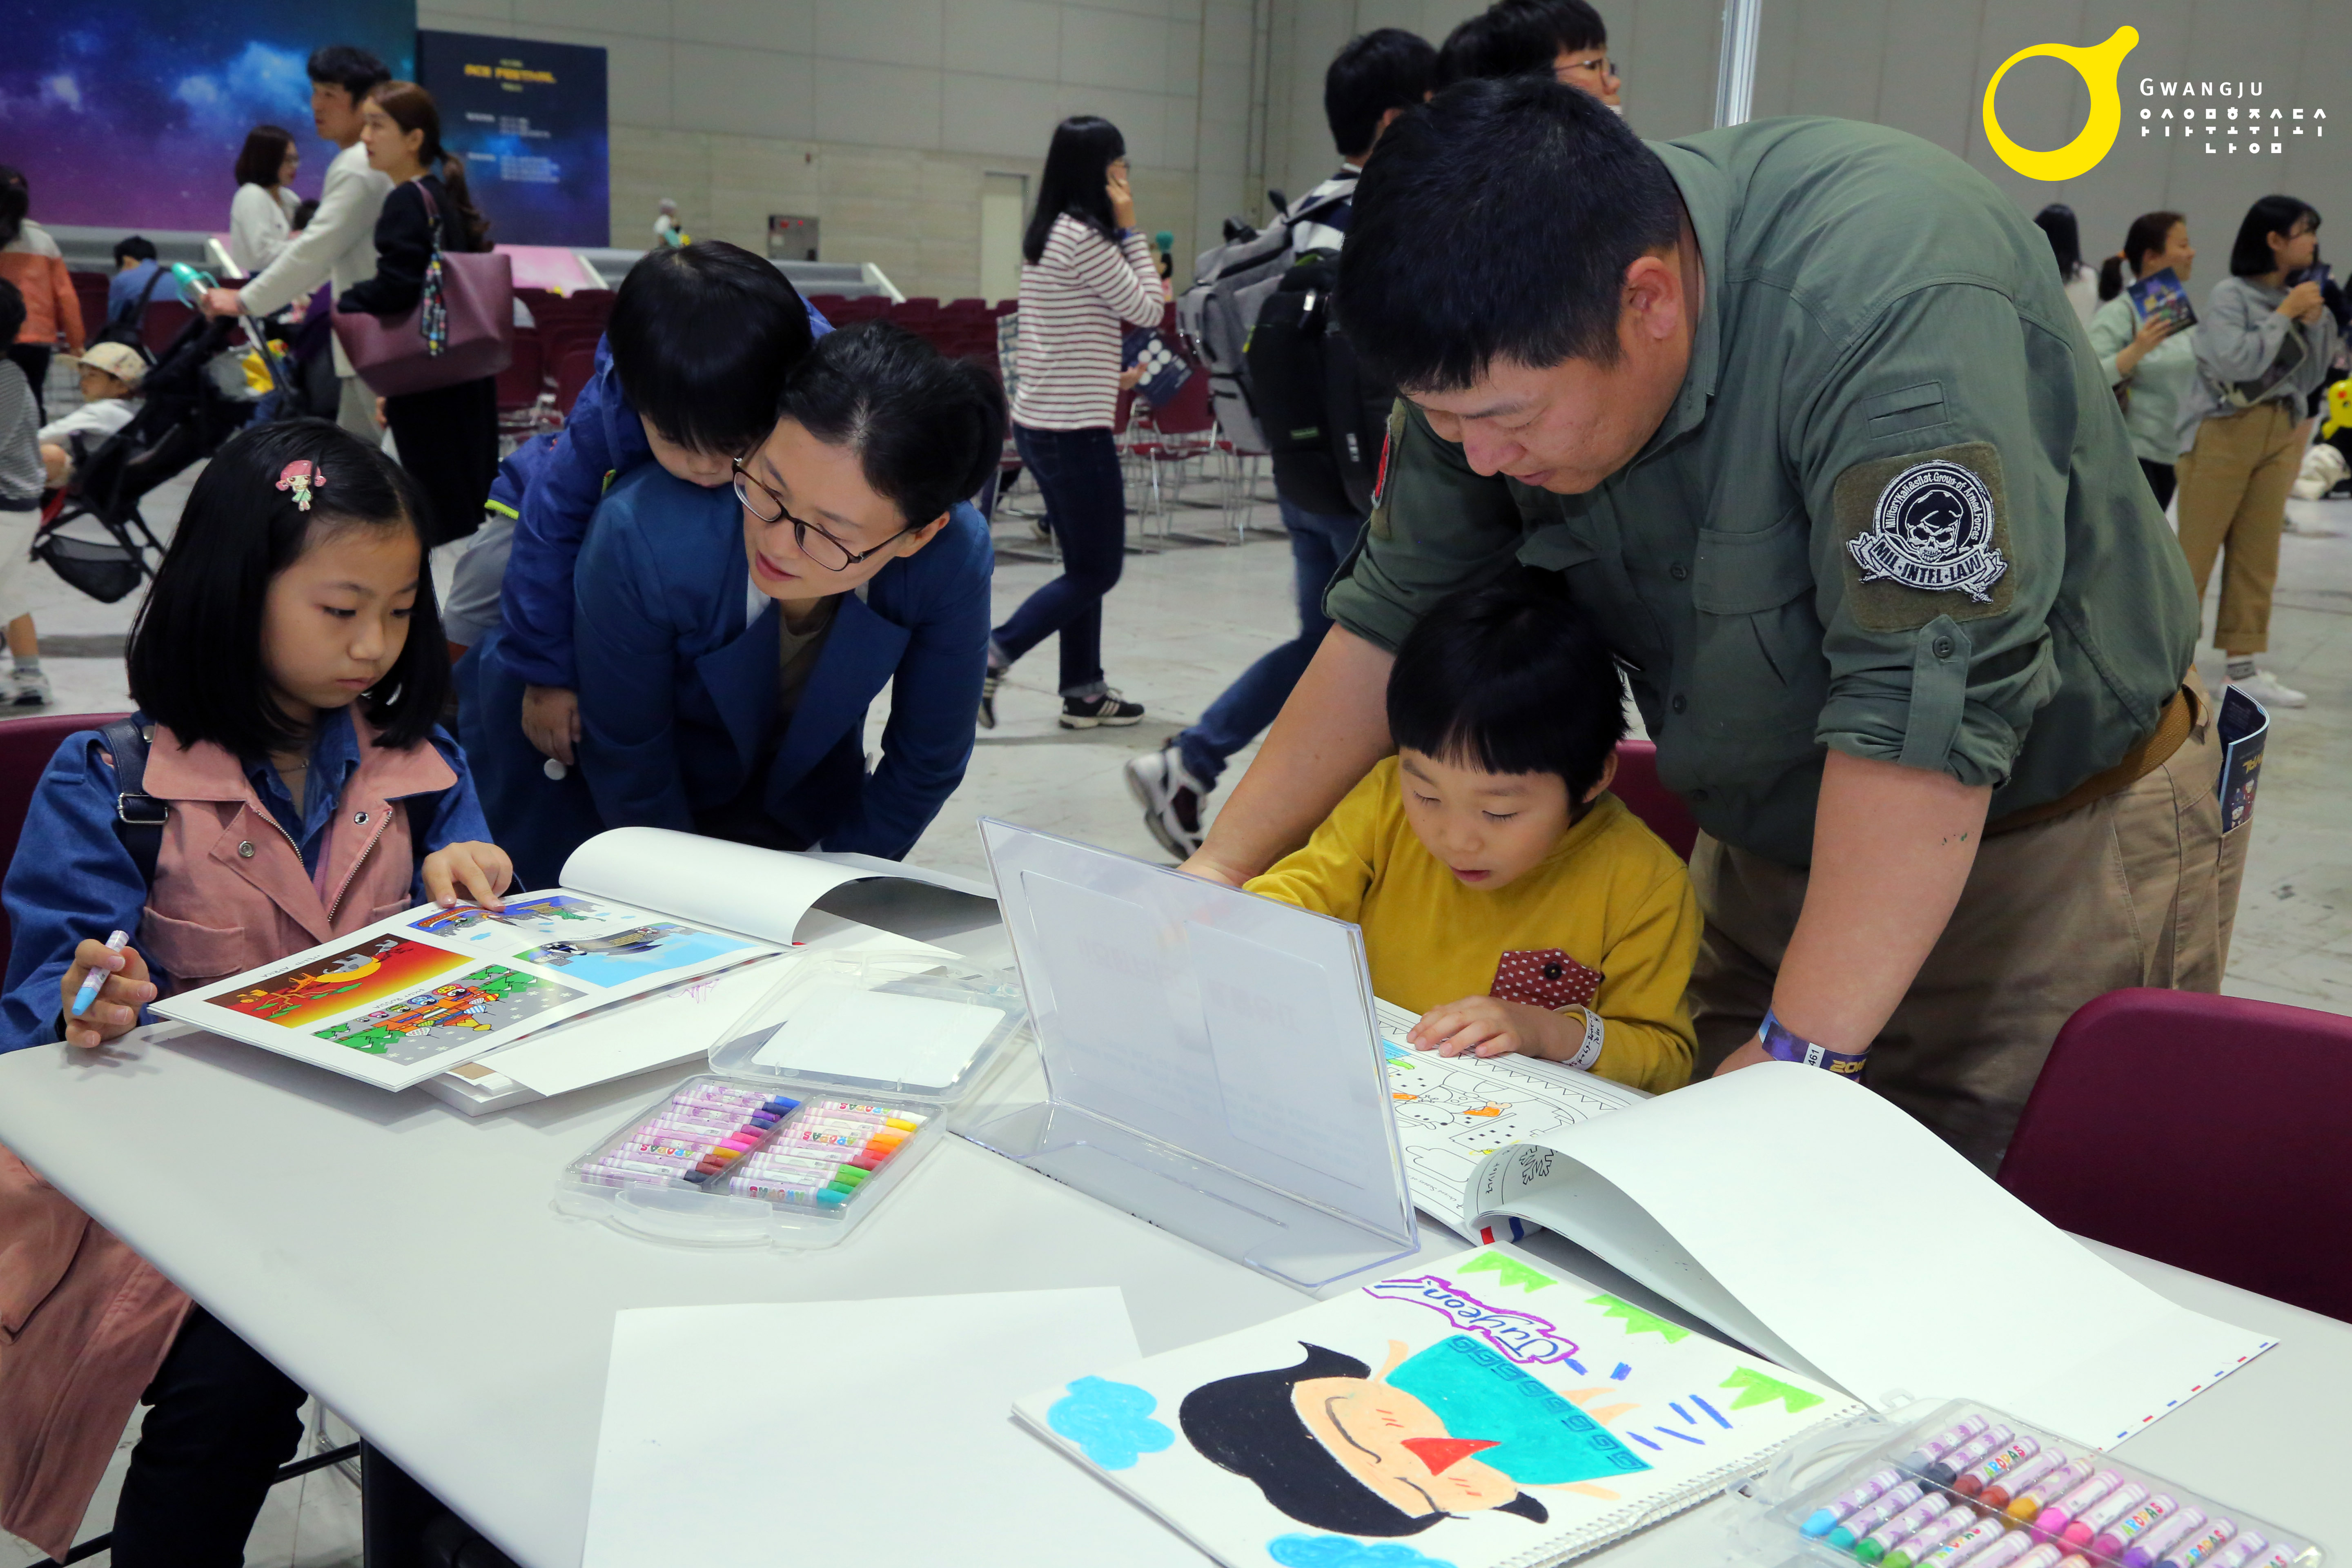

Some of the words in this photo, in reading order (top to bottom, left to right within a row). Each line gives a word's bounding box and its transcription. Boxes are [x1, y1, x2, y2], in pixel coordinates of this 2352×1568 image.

[1957, 482, 1966, 490] of
[1950, 555, 1982, 581] LAW
[260, 966, 290, 978] AFRICA
[374, 997, 404, 1009] RUSSIA
